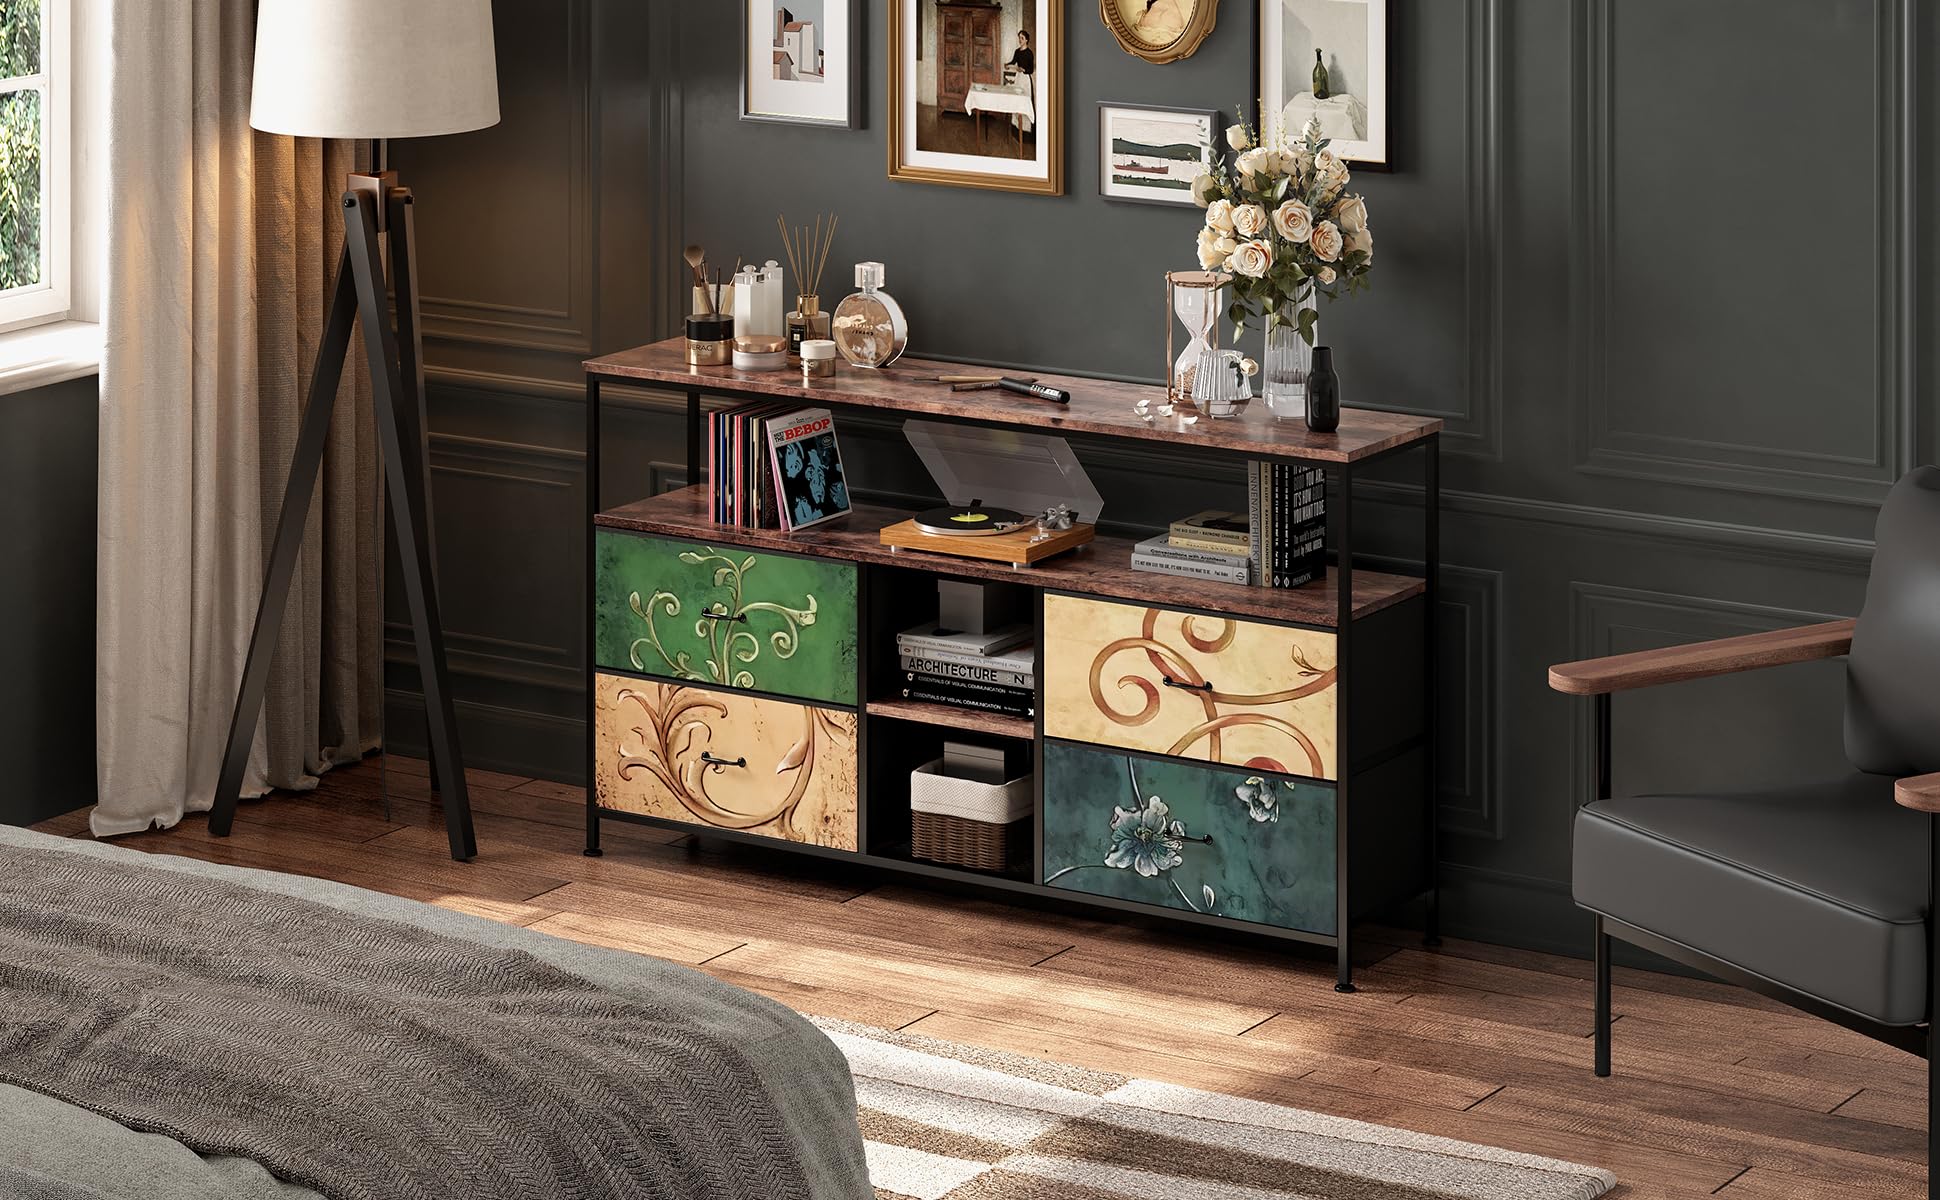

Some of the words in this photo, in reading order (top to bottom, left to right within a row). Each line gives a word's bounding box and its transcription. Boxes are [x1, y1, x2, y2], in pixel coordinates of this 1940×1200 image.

[784, 418, 830, 440] BEBOP
[1294, 508, 1302, 524] YOU
[1250, 473, 1260, 578] INNENARCHITEKTUR
[1150, 548, 1187, 557] Conversations
[908, 658, 998, 682] ARCHITECTURE
[918, 676, 944, 684] ESSENTIALS
[968, 683, 1006, 694] COMMUNICATION
[913, 692, 940, 700] ESSENTIALS
[946, 696, 962, 704] VISUAL
[963, 699, 1002, 710] COMMUNICATION
